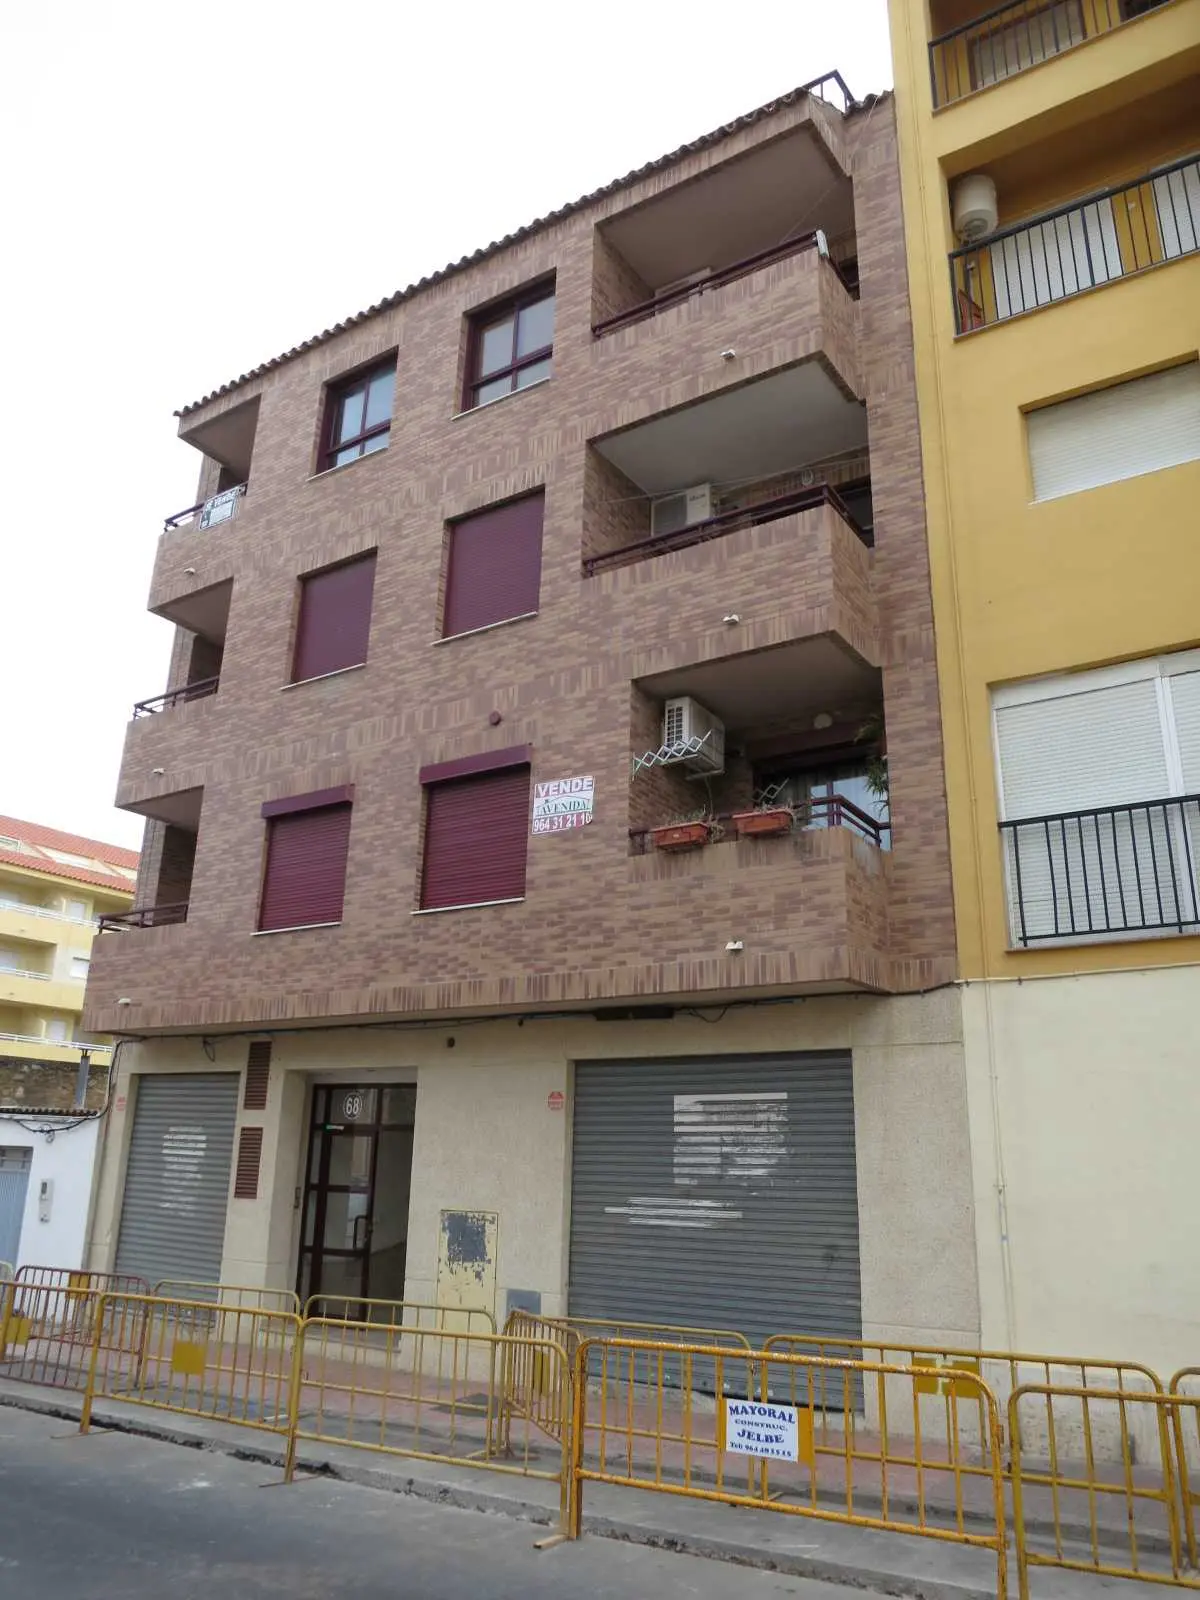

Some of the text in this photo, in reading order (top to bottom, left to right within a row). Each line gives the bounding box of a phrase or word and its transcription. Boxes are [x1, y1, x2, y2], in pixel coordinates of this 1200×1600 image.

[538, 778, 593, 797] VENDE
[533, 818, 550, 832] 964
[552, 815, 563, 829] 31
[565, 813, 577, 828] 21
[346, 1097, 360, 1114] 68
[728, 1405, 796, 1424] MAYORAL
[737, 1429, 785, 1443] JELBE
